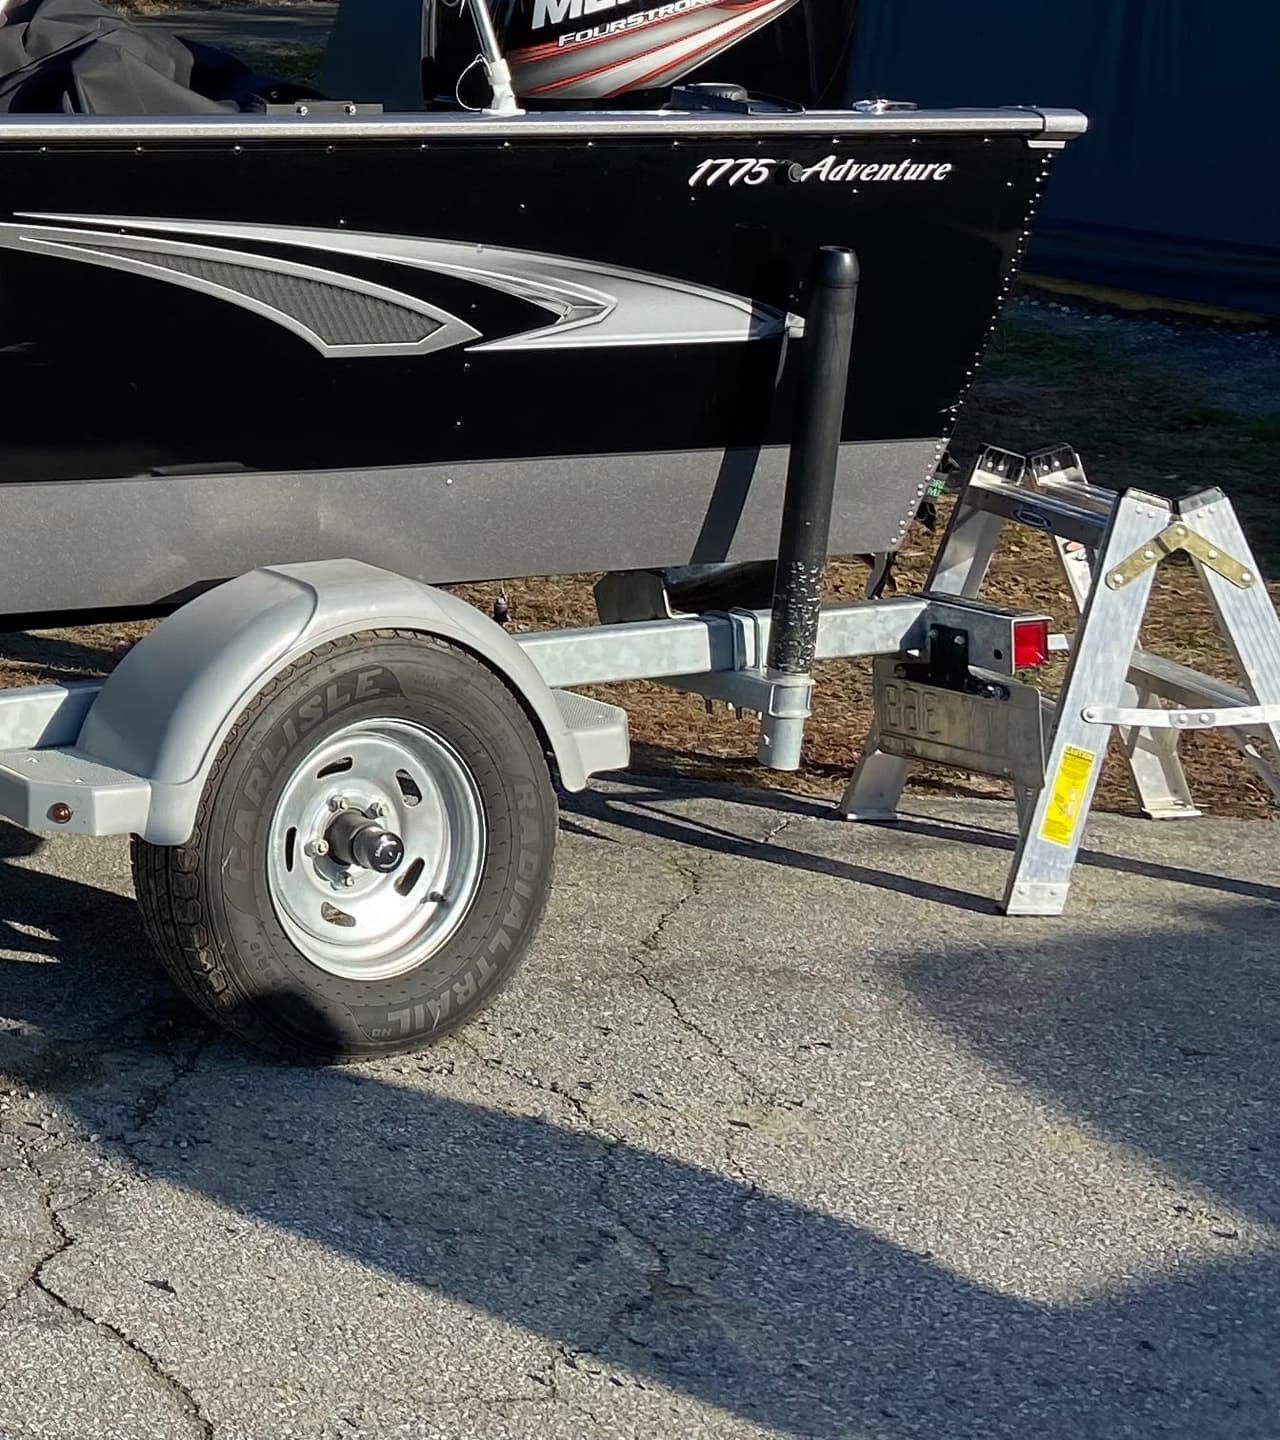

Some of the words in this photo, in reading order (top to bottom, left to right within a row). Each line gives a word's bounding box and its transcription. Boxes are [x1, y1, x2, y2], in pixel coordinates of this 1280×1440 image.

[688, 158, 776, 187] 1775
[800, 155, 952, 183] Adventure
[228, 666, 384, 882] CARLISLE
[489, 782, 538, 955] RADIAL
[388, 955, 498, 1034] TRAIL
